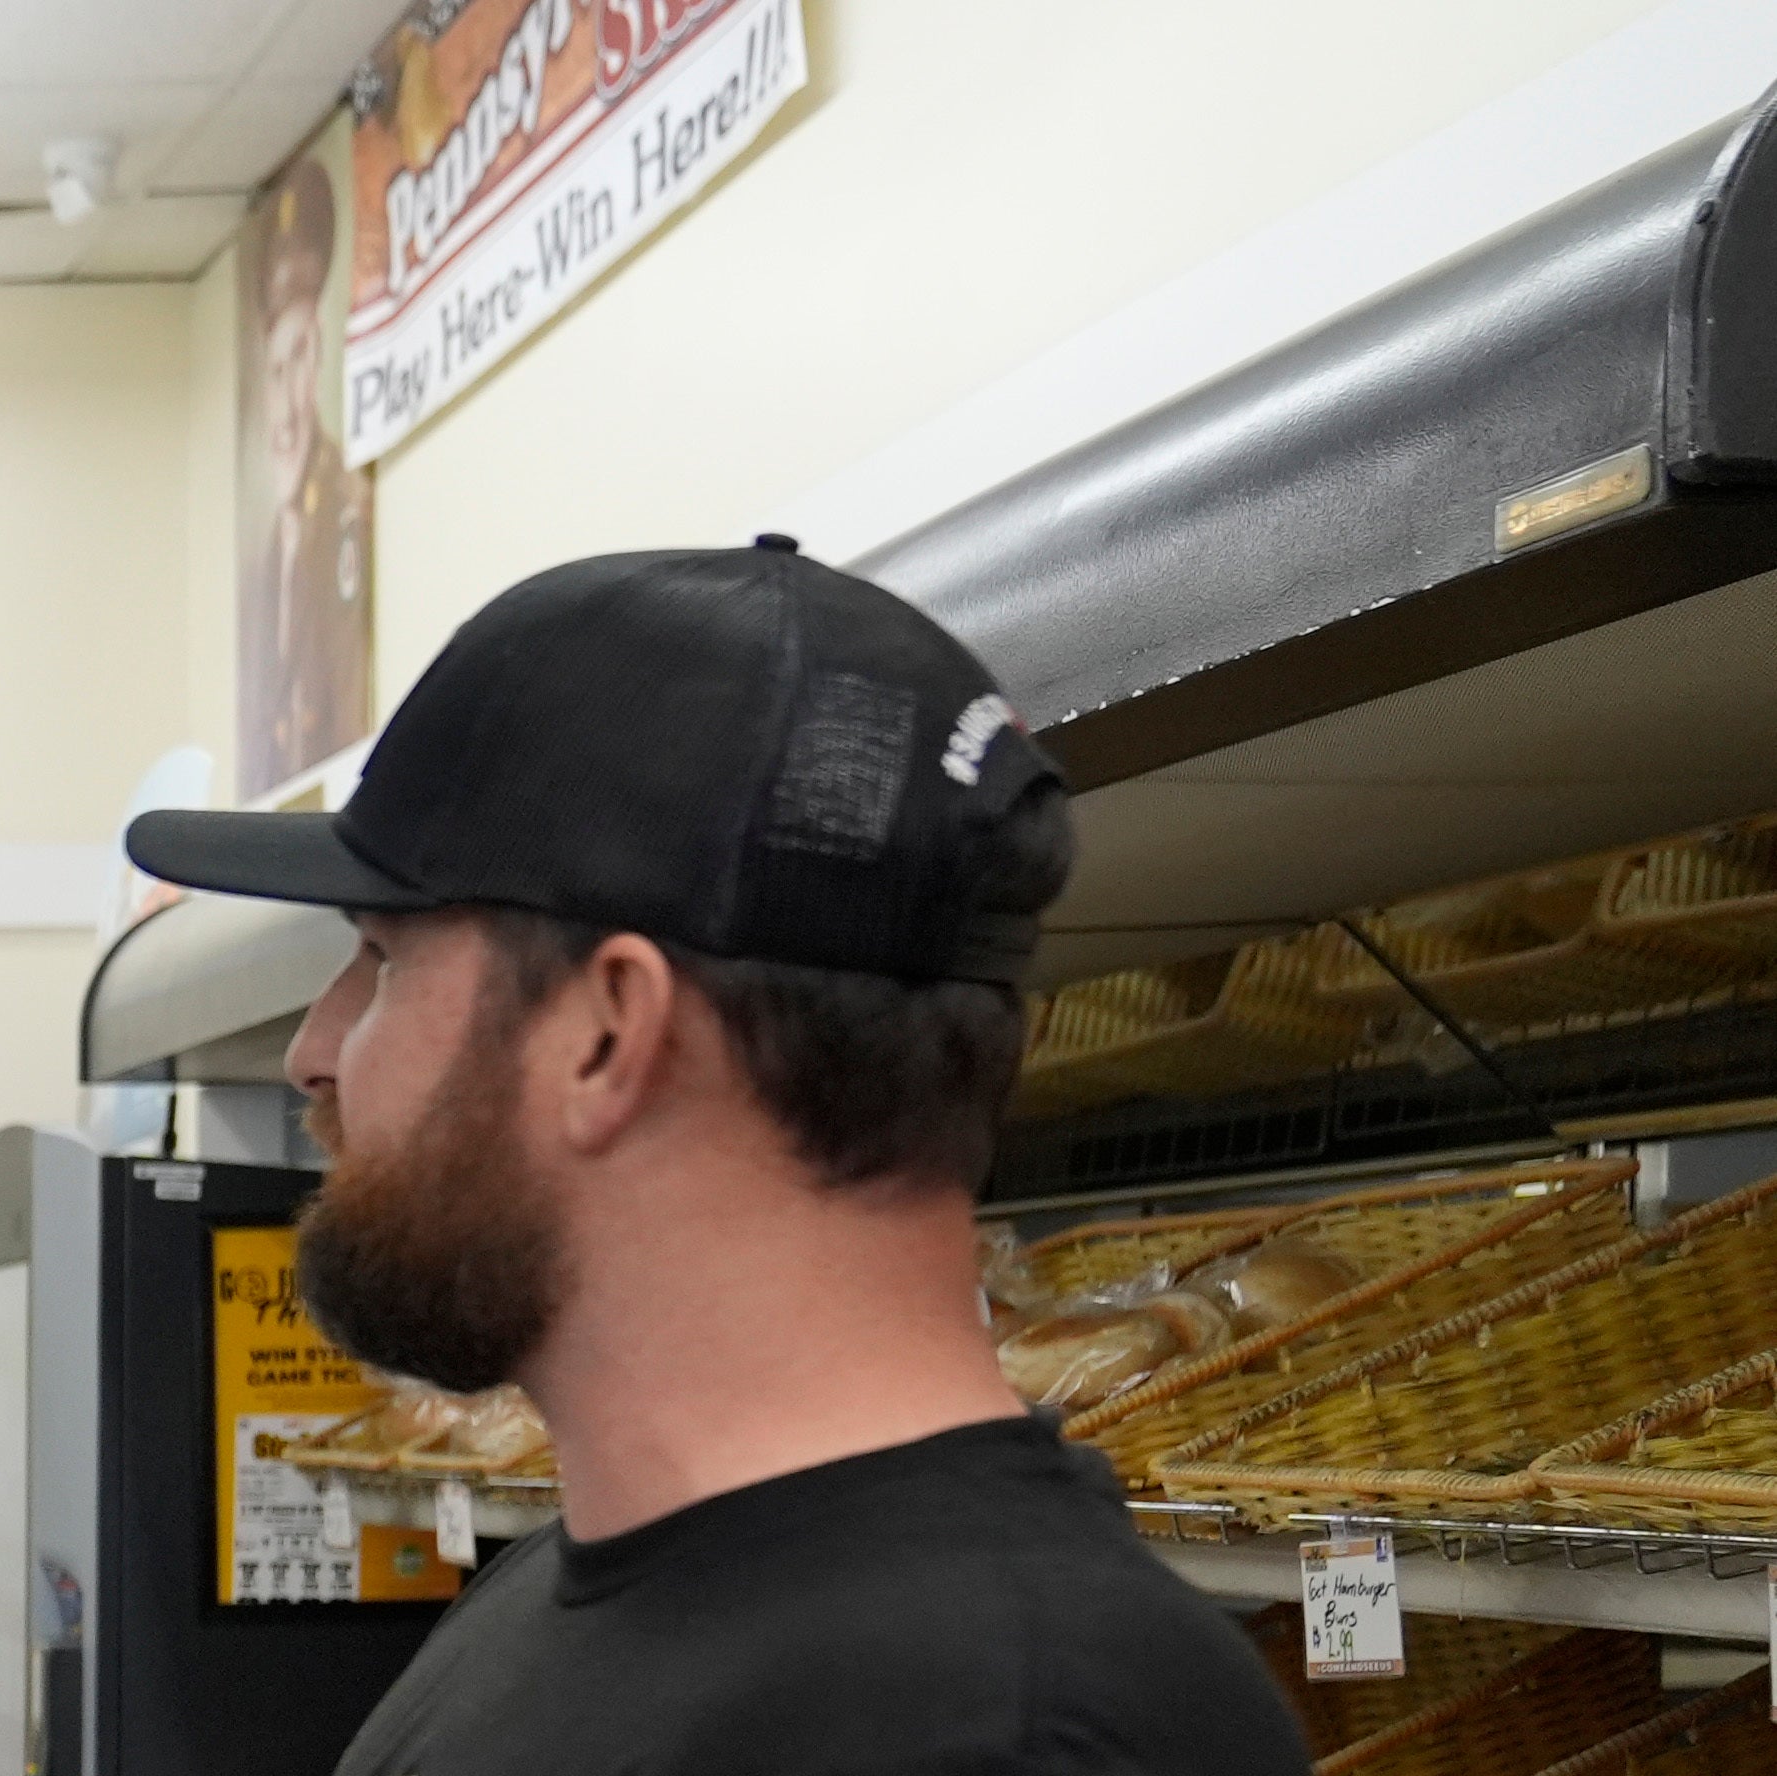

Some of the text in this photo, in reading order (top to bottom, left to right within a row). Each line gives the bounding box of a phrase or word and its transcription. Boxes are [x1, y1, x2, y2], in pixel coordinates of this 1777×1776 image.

[349, 343, 433, 438] Play
[1333, 1574, 1396, 1608] Hamburger
[1325, 1600, 1357, 1628] Buns
